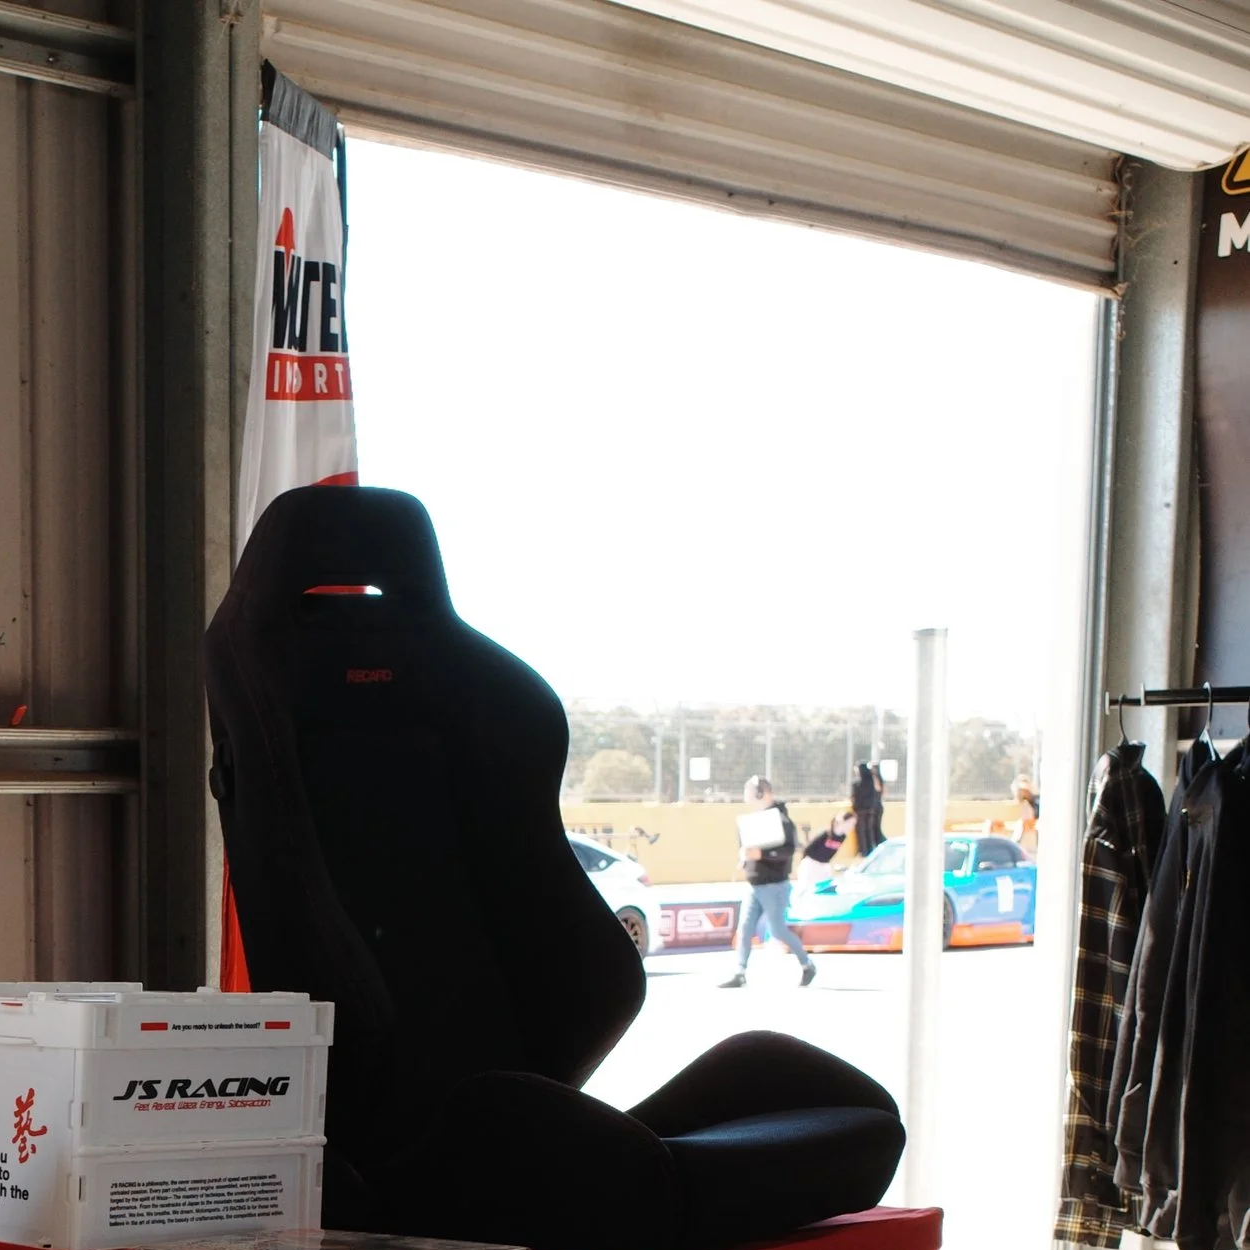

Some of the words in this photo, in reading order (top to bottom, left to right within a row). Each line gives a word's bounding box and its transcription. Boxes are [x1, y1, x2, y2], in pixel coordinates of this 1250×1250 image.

[1217, 211, 1250, 257] M
[113, 1079, 162, 1101] J'S
[165, 1077, 291, 1099] RACING
[10, 1185, 29, 1200] the
